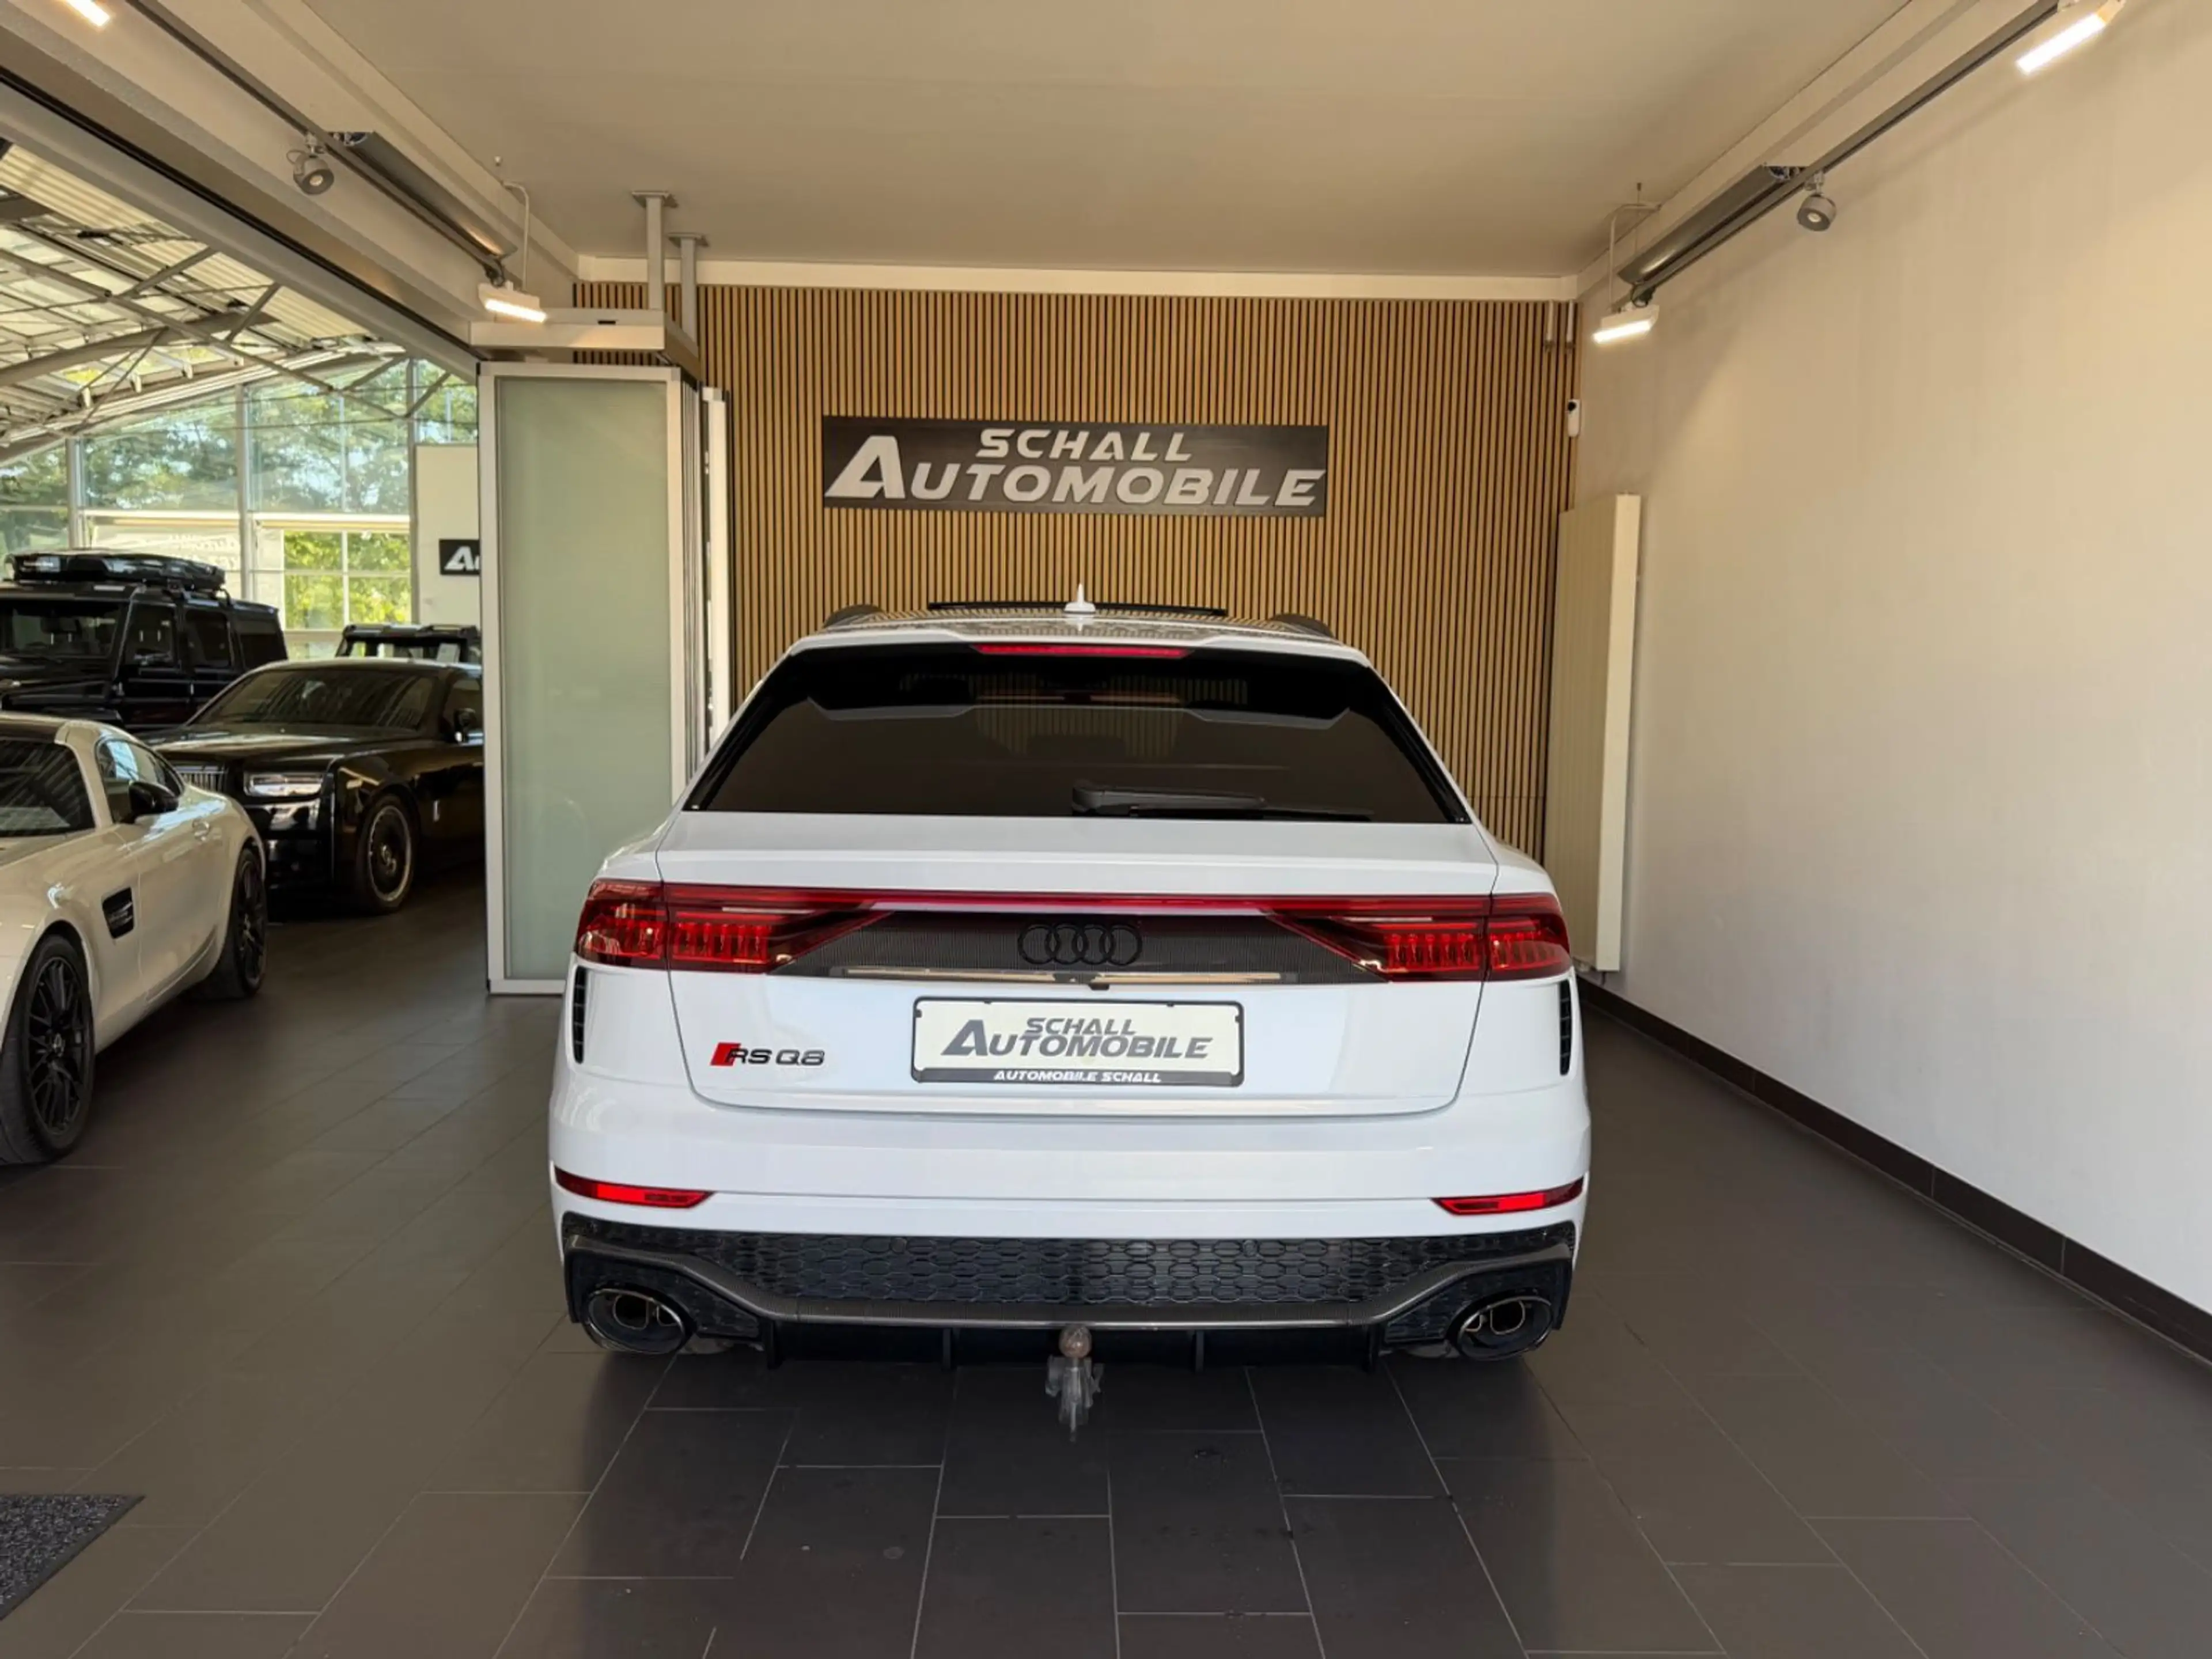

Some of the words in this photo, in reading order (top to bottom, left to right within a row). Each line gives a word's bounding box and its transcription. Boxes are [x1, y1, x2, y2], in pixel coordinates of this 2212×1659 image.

[976, 428, 1194, 461] SCHALL
[824, 435, 1327, 506] AUTOMOBILE
[444, 546, 480, 570] A
[1025, 1017, 1136, 1036] SCHALL
[940, 1019, 1213, 1059] AUTOMOBILE
[725, 1048, 772, 1065] RS
[775, 1049, 825, 1066] Q8
[994, 1070, 1097, 1082] AUTOMOBILE
[1101, 1071, 1162, 1083] SCHALL
